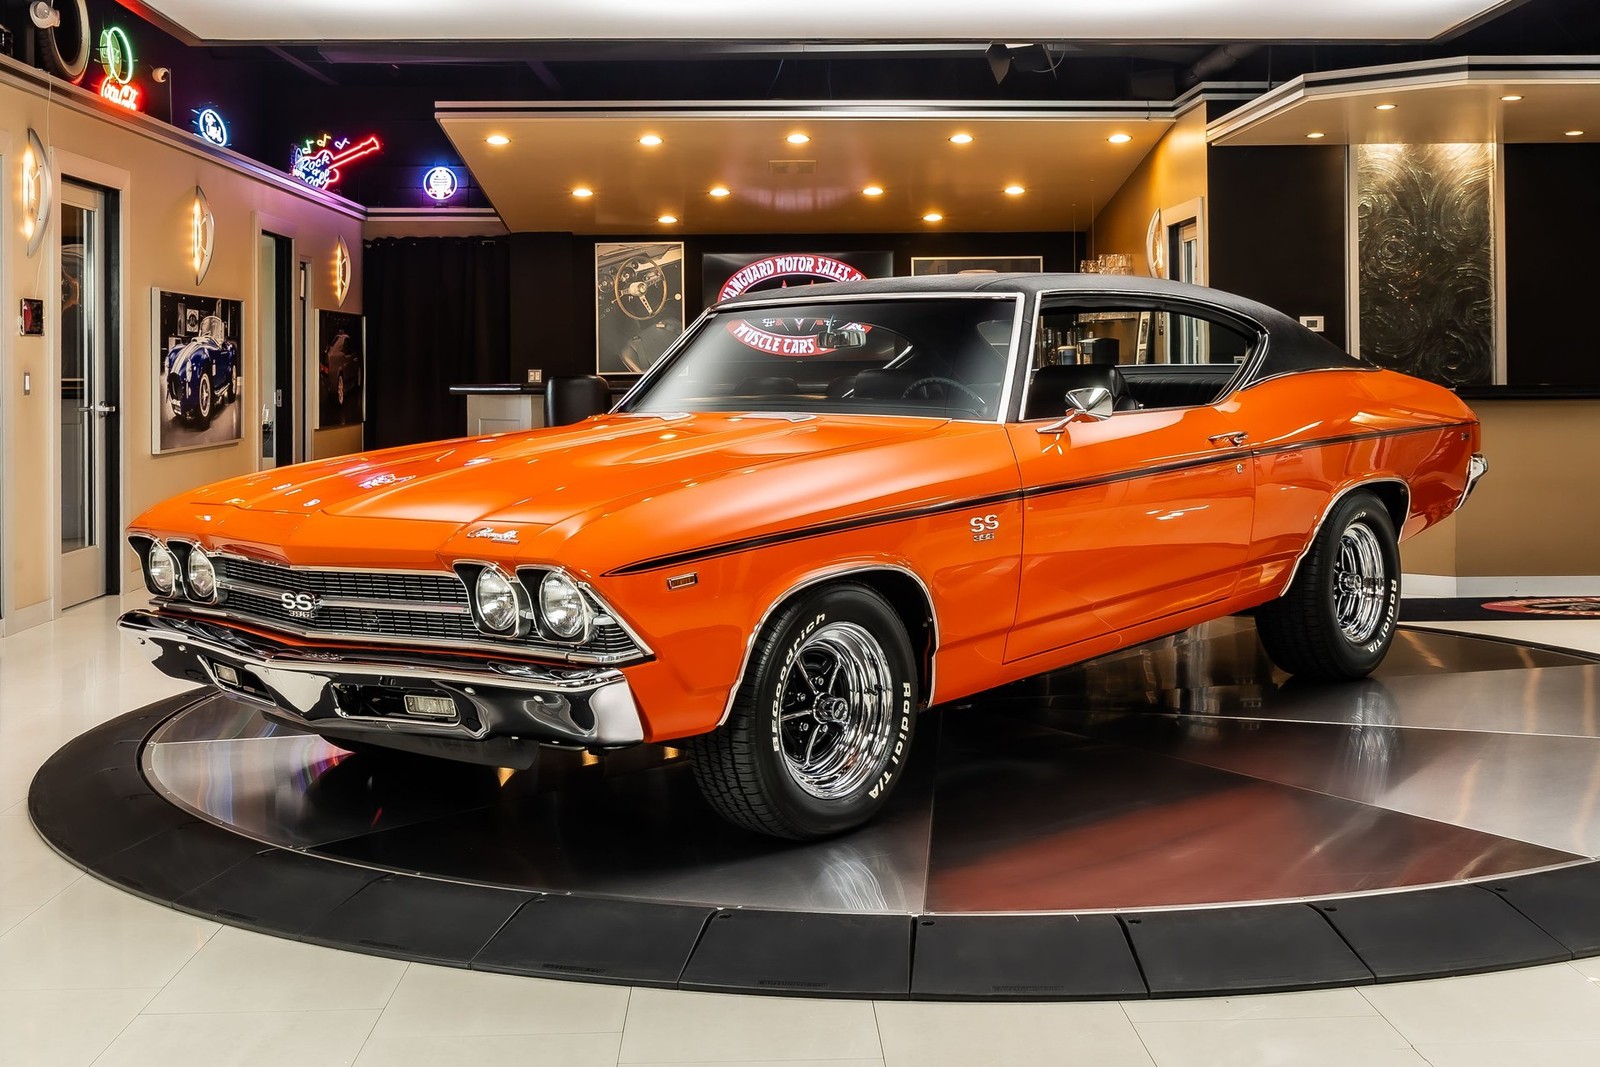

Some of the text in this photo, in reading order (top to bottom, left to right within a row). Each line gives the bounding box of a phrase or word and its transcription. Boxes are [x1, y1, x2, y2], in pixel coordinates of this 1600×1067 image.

[301, 152, 330, 172] Rock
[775, 256, 814, 272] MOTOR
[733, 323, 815, 354] MUSCLE CARS
[970, 514, 999, 532] SS
[281, 592, 312, 610] SS
[1381, 579, 1397, 637] Radial
[772, 613, 826, 752] BFGoodrich
[868, 682, 911, 799] Radial T/A
